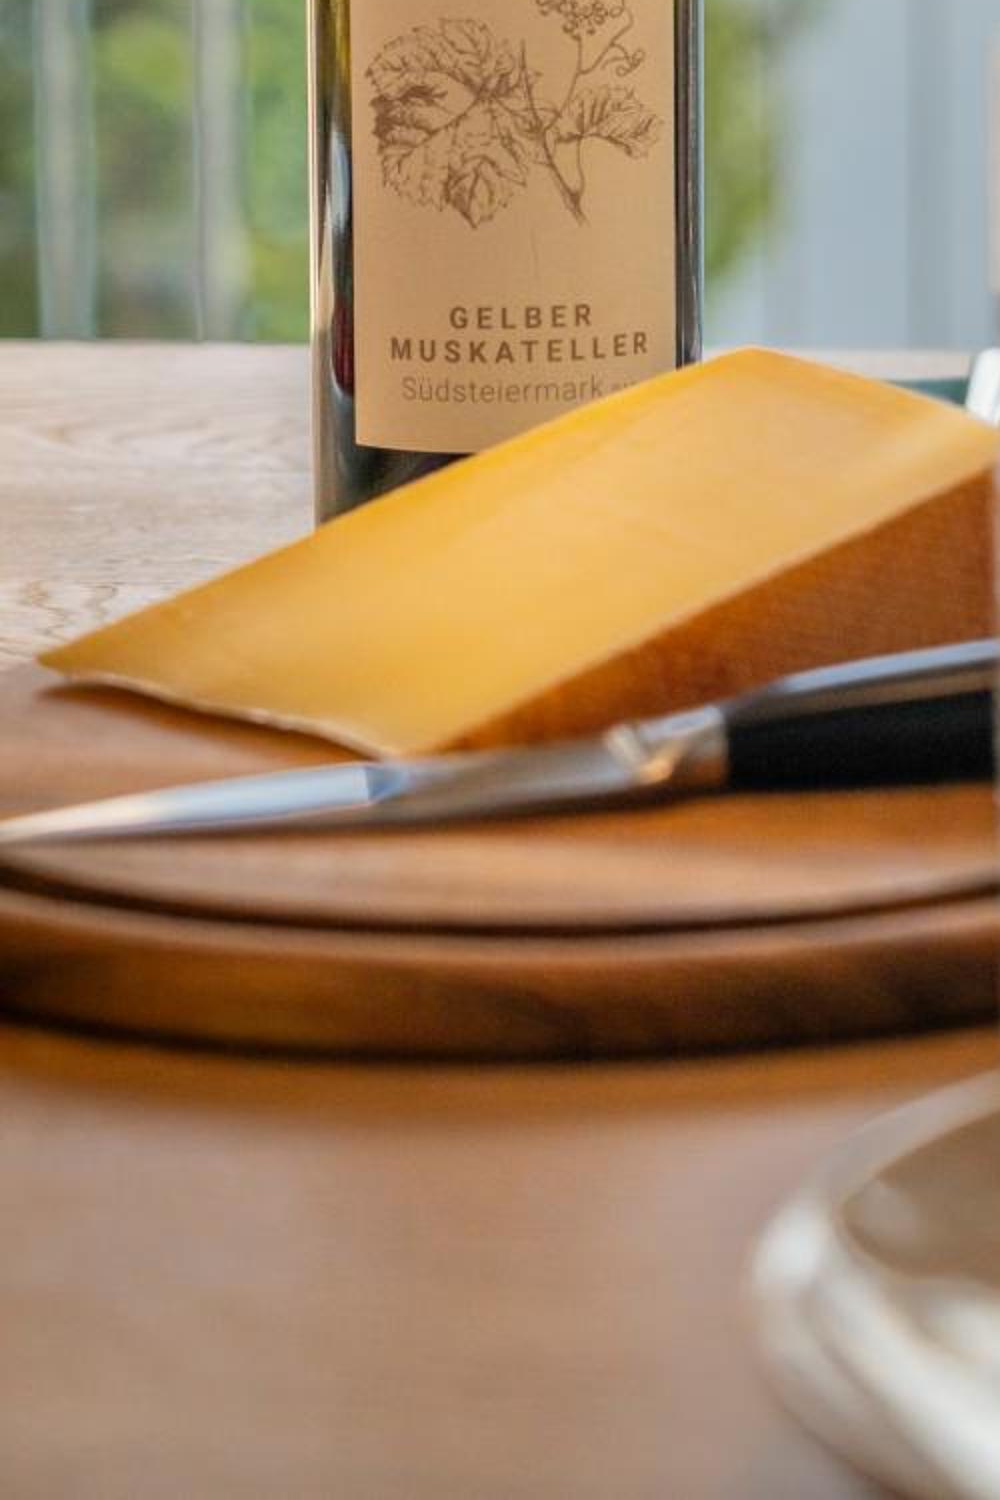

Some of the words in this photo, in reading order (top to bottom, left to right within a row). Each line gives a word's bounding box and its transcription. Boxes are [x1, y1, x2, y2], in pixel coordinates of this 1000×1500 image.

[448, 303, 593, 329] GELBER
[390, 330, 649, 364] MUSKATELLER
[401, 374, 604, 404] Südsteiermark
